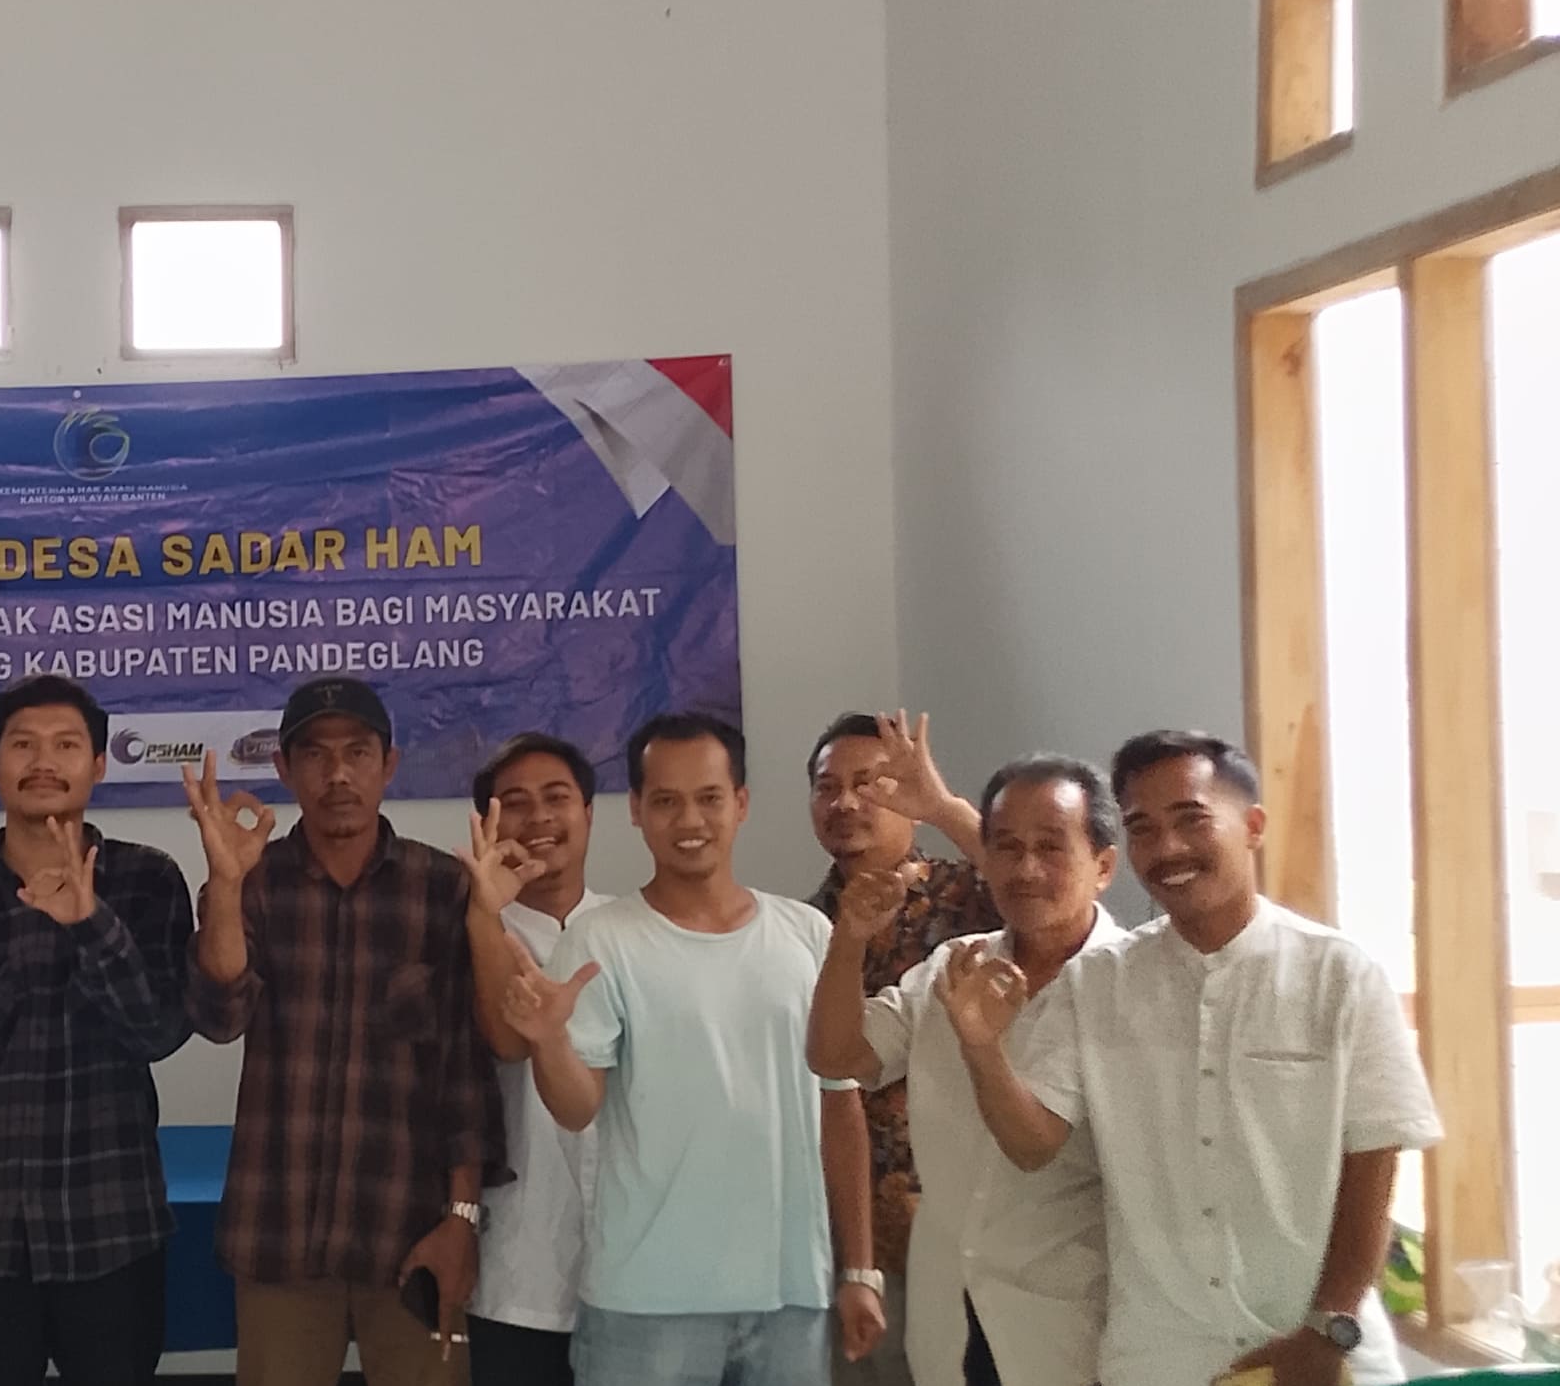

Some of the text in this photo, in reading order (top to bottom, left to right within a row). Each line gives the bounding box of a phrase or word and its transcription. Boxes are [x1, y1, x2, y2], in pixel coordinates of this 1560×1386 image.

[161, 530, 347, 577] SADAR
[365, 525, 482, 569] HAM
[49, 603, 154, 634] ASASI
[167, 599, 324, 631] MANUSIA
[336, 596, 413, 626] BAGI
[425, 588, 661, 623] MASYARAKAT
[24, 645, 236, 678] KABUPATEN
[249, 639, 484, 673] PANDEGLANG
